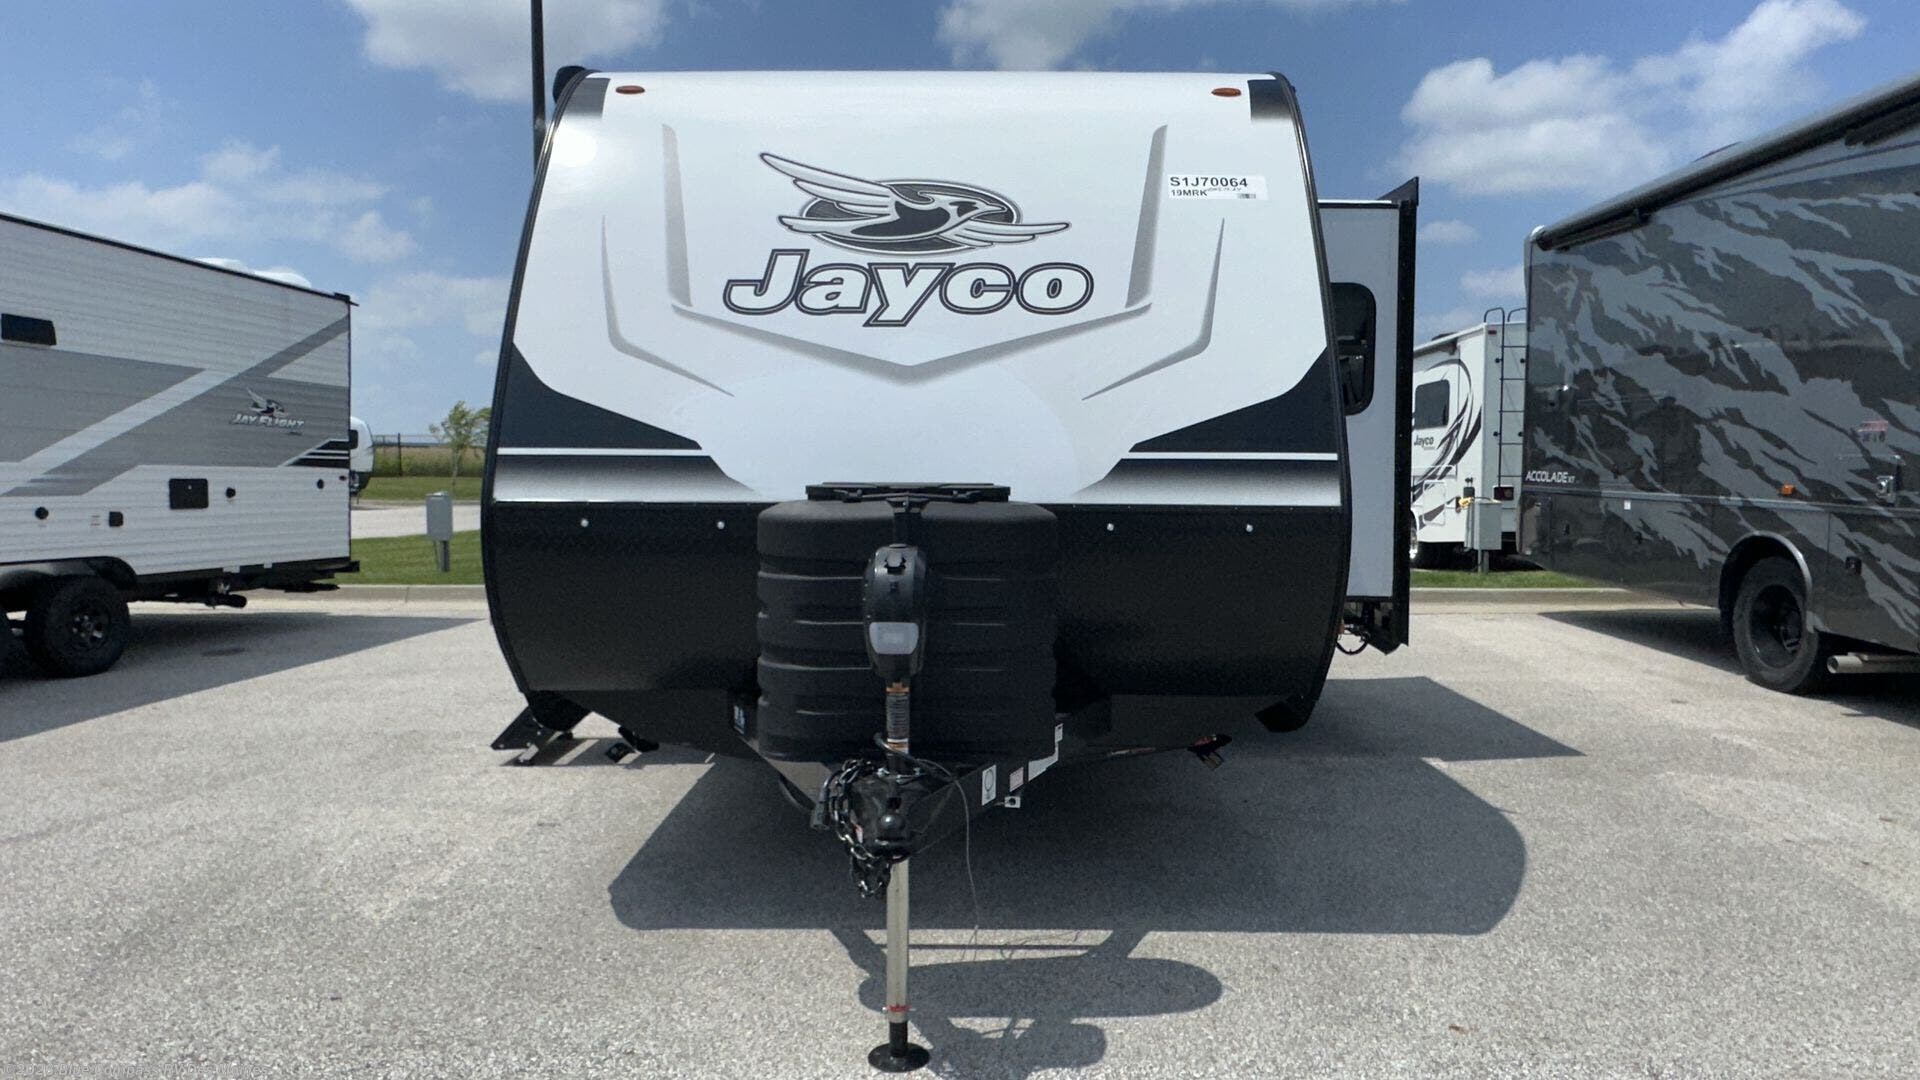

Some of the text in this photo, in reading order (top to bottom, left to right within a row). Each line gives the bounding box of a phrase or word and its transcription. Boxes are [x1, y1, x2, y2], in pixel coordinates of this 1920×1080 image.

[1170, 176, 1248, 187] S1J70064
[723, 248, 1094, 327] Jayco
[232, 413, 257, 425] JAY
[1525, 470, 1568, 483] ACCOLADE
